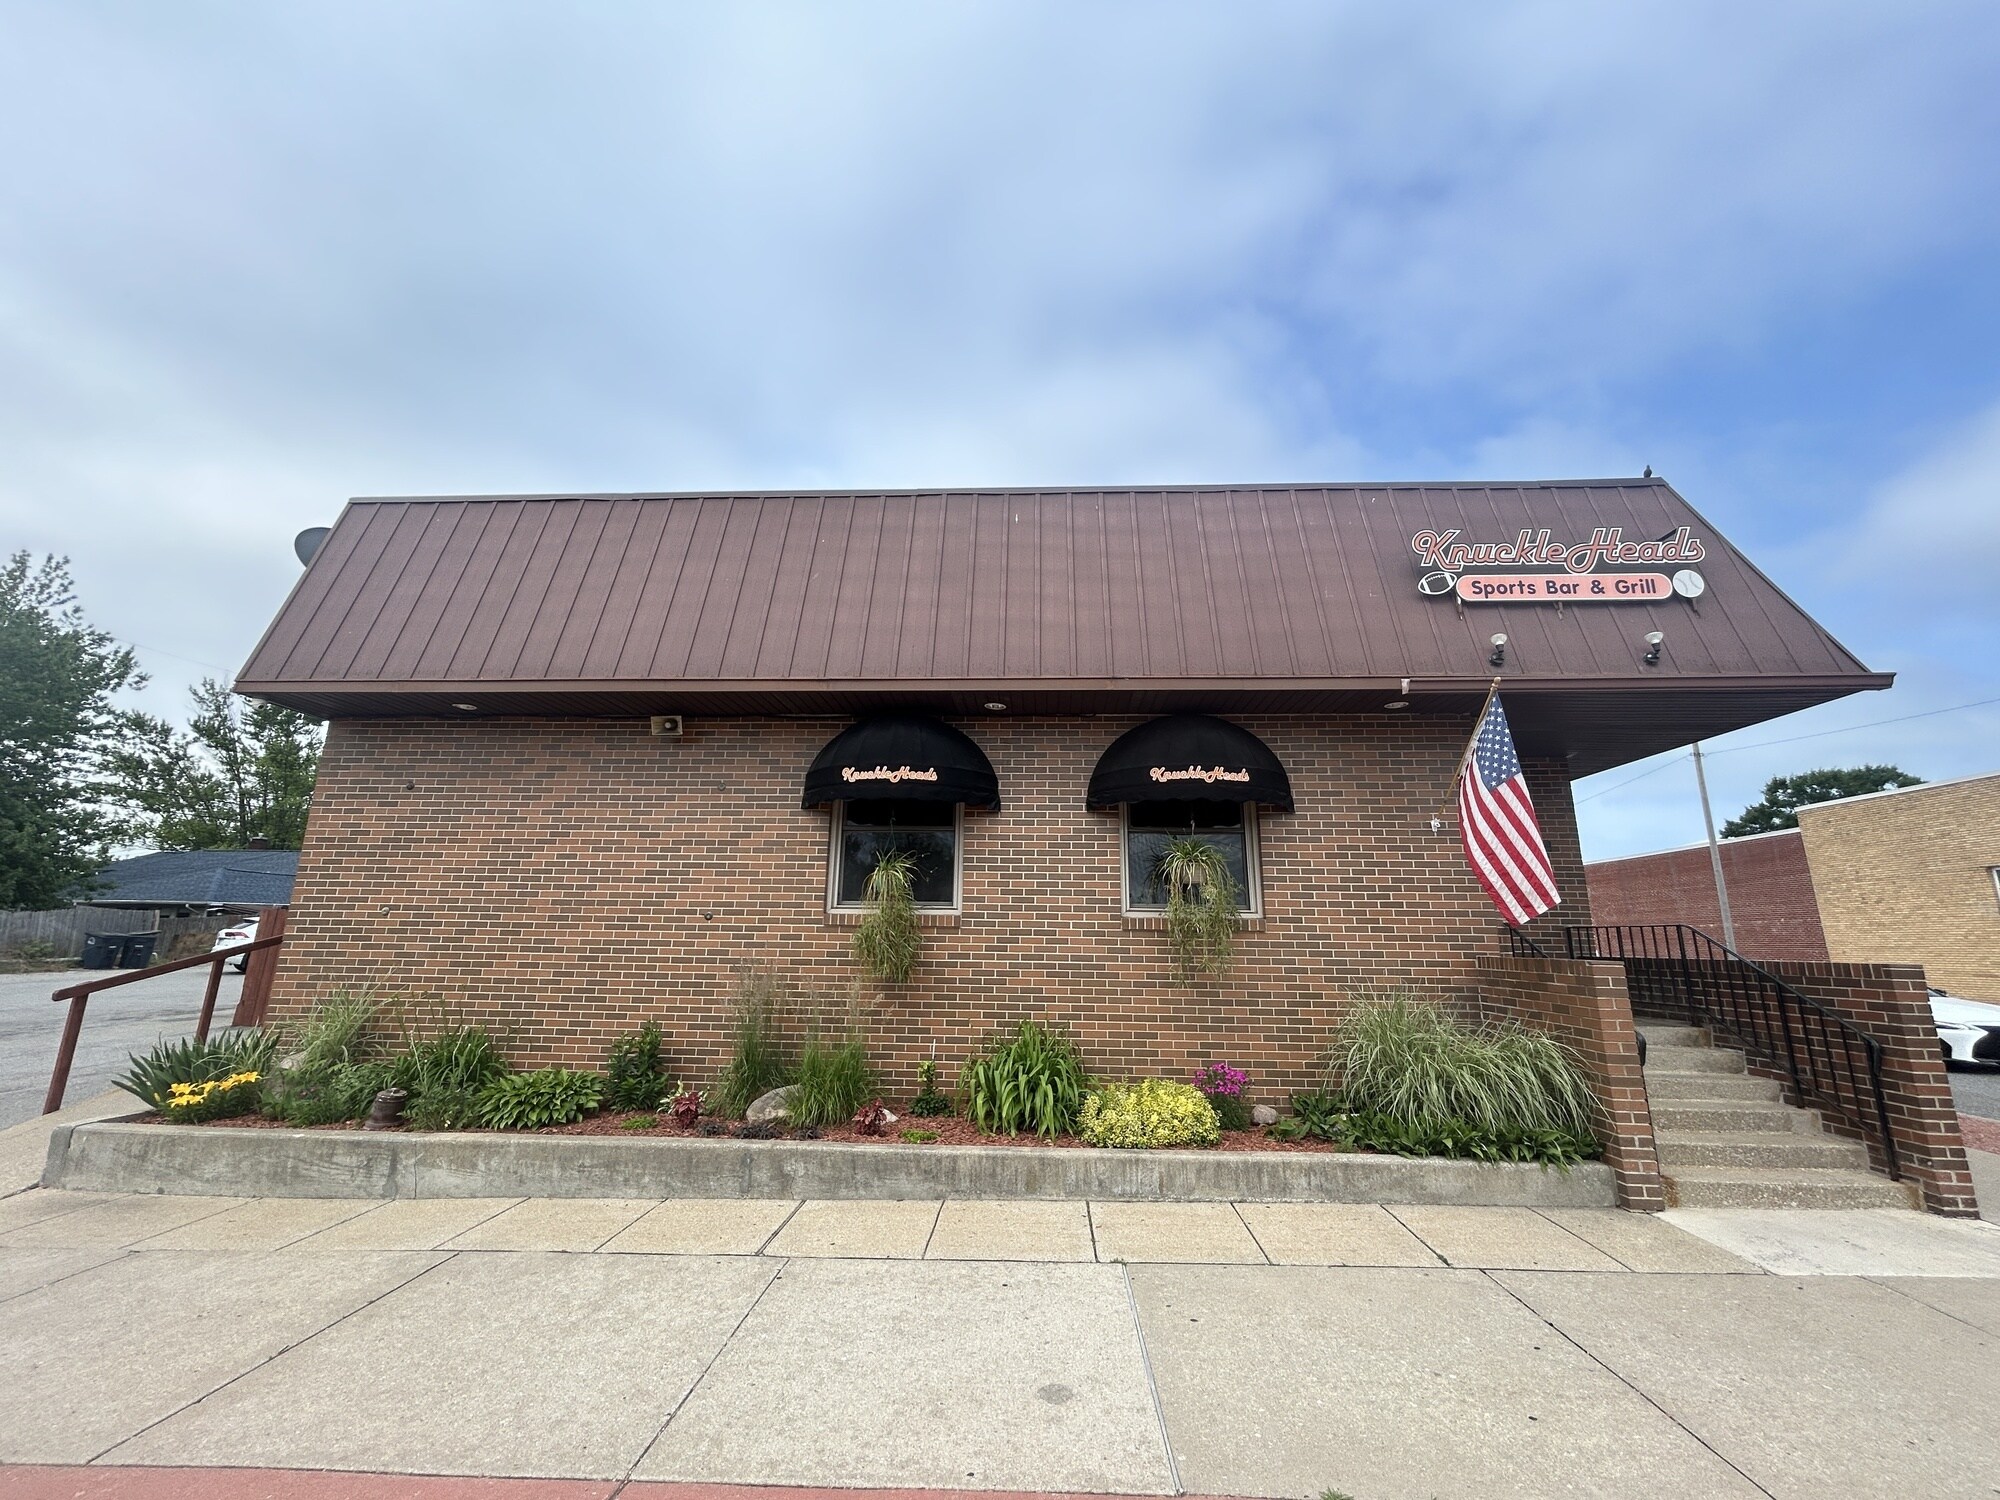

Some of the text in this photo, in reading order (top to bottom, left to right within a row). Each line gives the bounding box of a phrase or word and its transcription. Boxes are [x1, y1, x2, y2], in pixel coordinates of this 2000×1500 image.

[1471, 578, 1657, 599] Sports Bar & Grill
